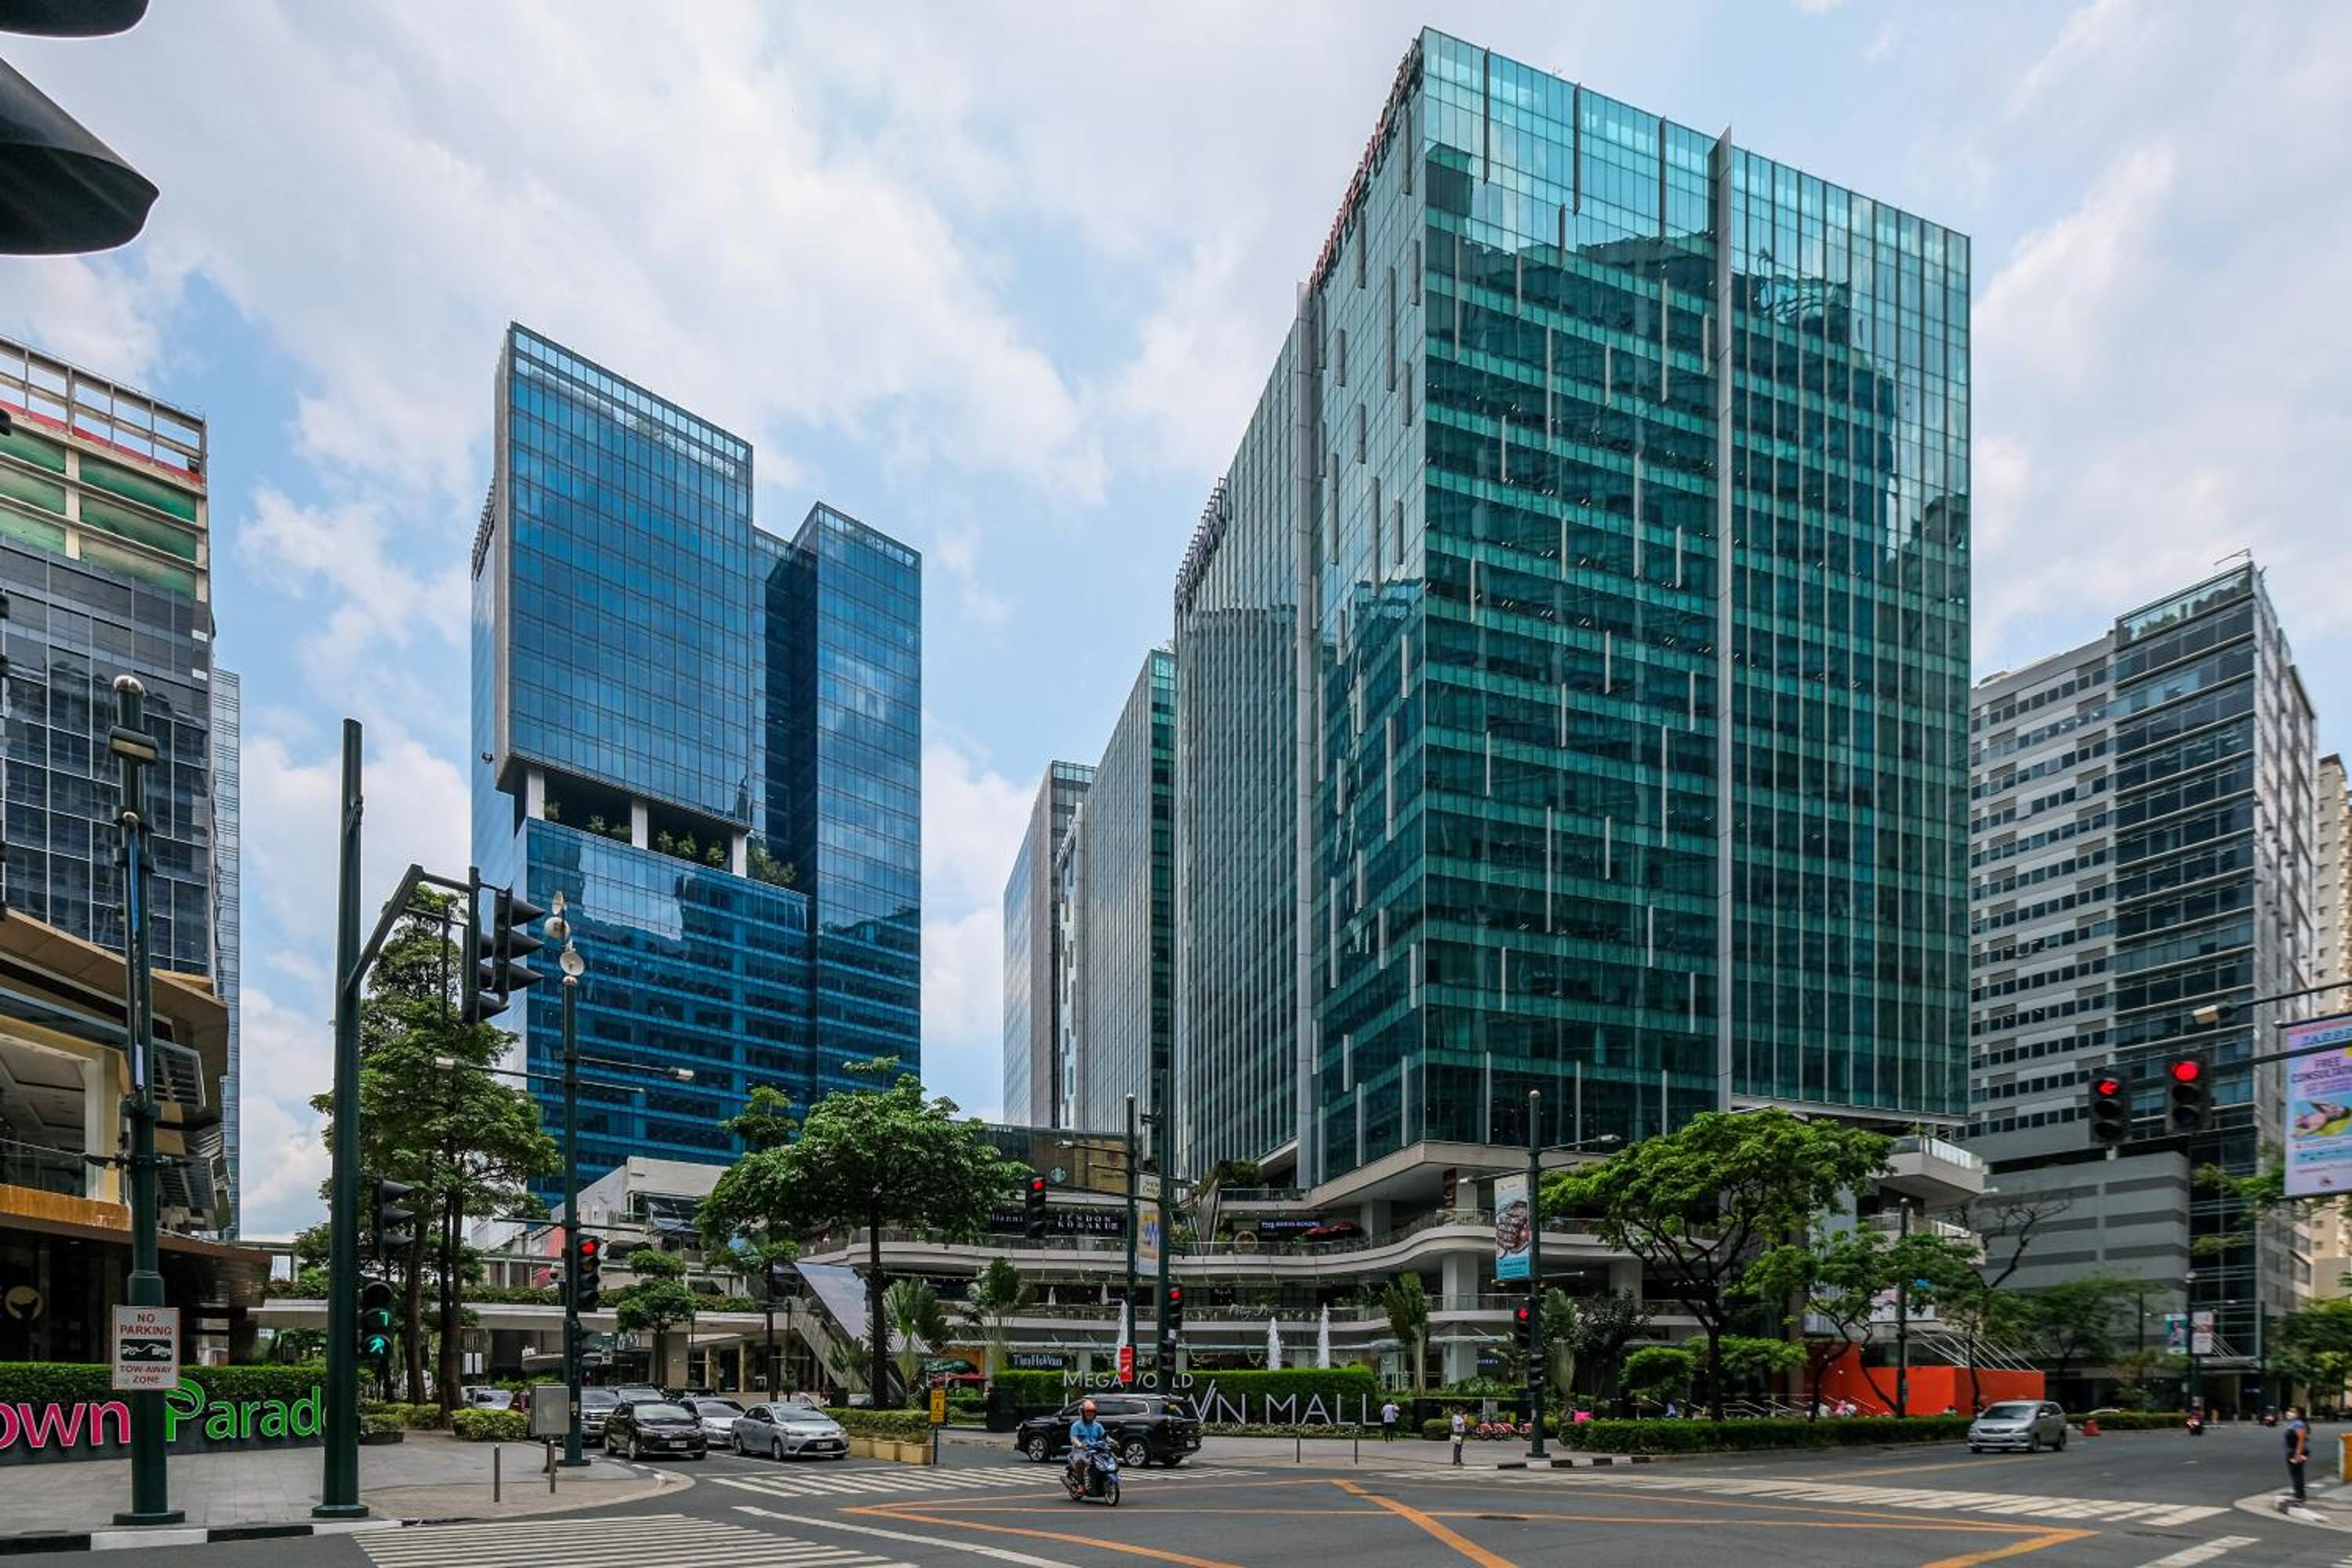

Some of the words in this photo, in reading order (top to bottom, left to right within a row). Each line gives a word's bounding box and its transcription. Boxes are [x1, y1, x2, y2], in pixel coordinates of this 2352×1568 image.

[137, 1313, 156, 1323] NO
[120, 1324, 172, 1335] PARKING
[119, 1364, 172, 1374] TOW-AWAY
[132, 1375, 160, 1384] ZONE
[165, 1377, 326, 1442] Parad
[1265, 1392, 1382, 1426] MALL
